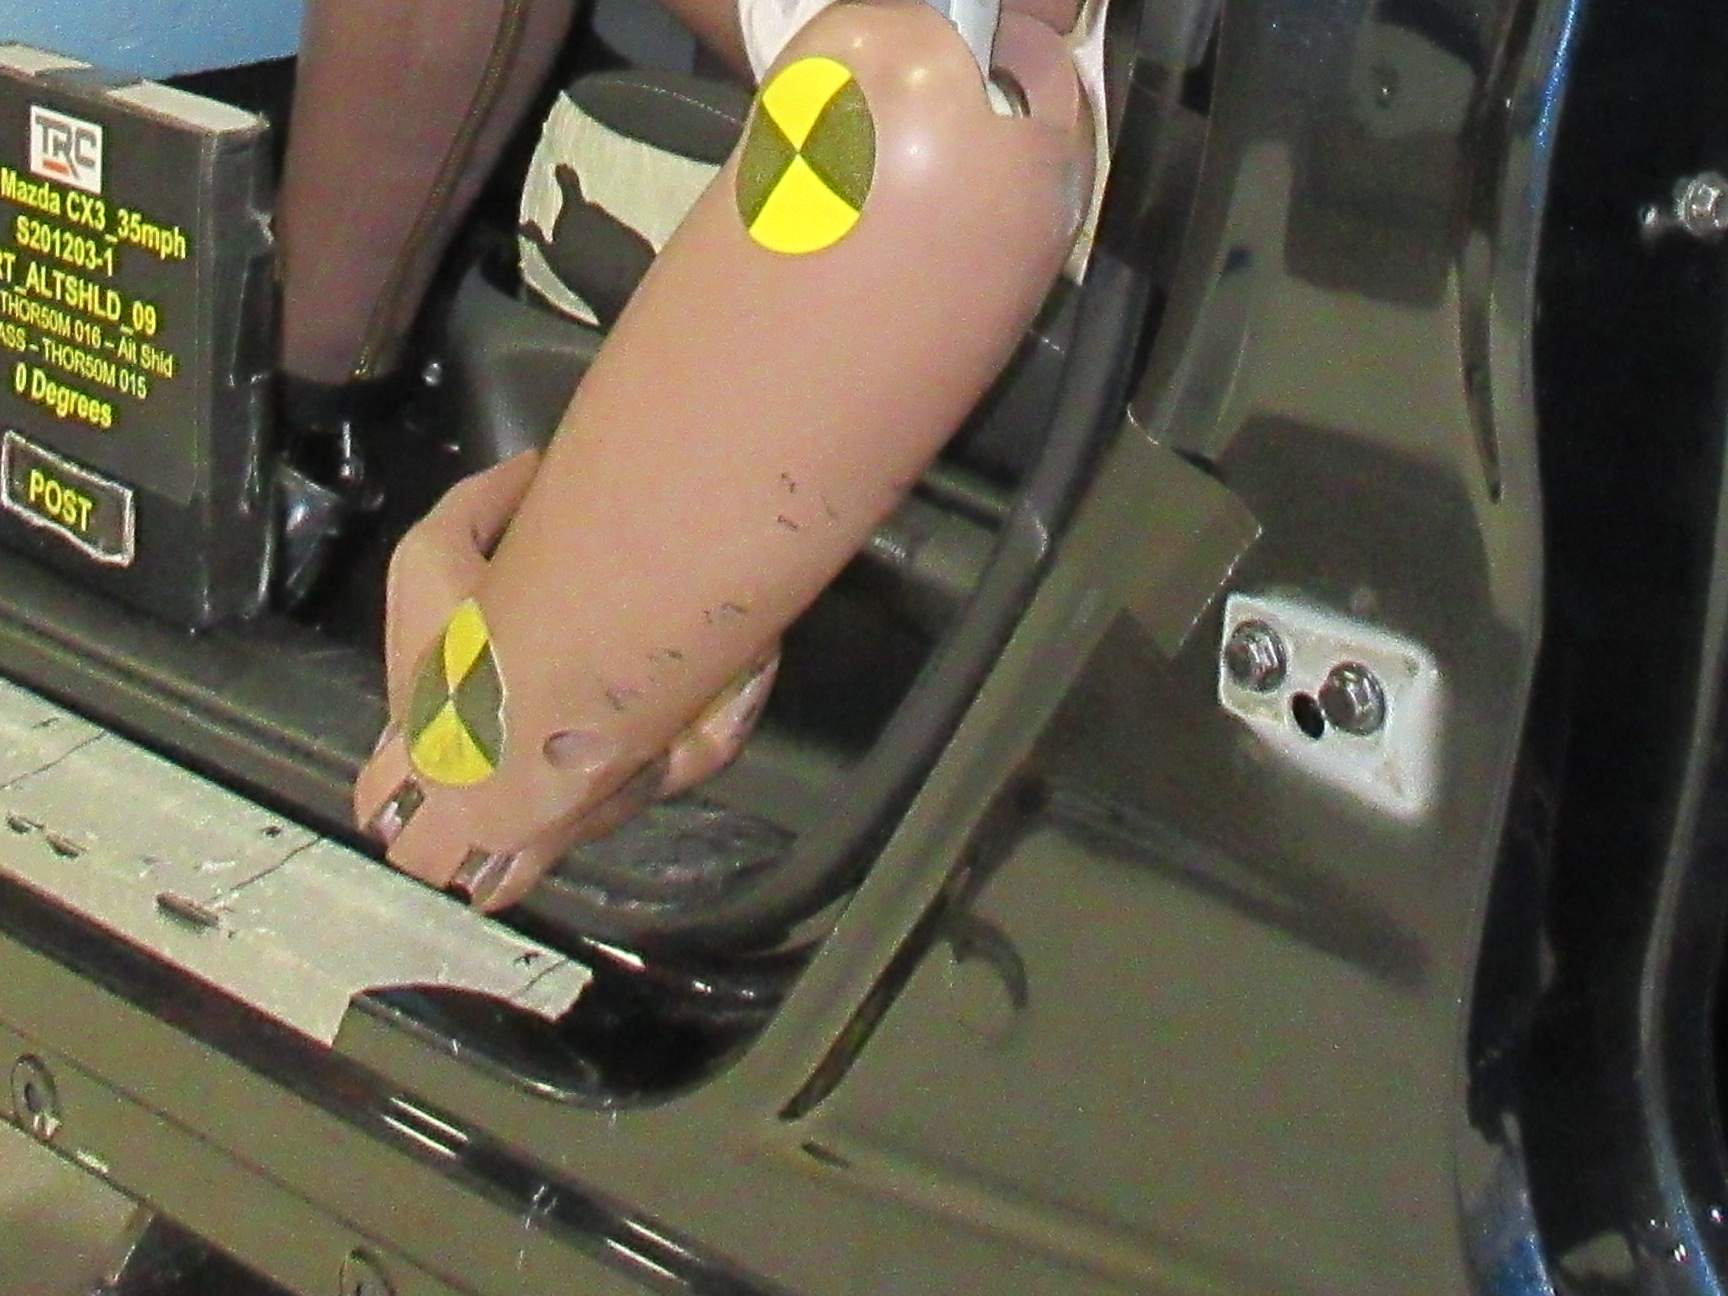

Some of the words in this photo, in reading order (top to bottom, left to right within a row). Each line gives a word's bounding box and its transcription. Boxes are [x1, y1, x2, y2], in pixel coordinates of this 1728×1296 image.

[36, 117, 97, 179] TRC
[0, 167, 61, 215] Mazda
[16, 214, 115, 277] S201203-1
[0, 292, 72, 338] THOR50M
[73, 320, 102, 348] 016
[14, 362, 27, 393] 0
[31, 369, 113, 430] Degrees
[42, 337, 117, 388] THOR50M
[118, 371, 147, 400] 015
[29, 468, 93, 533] POST
